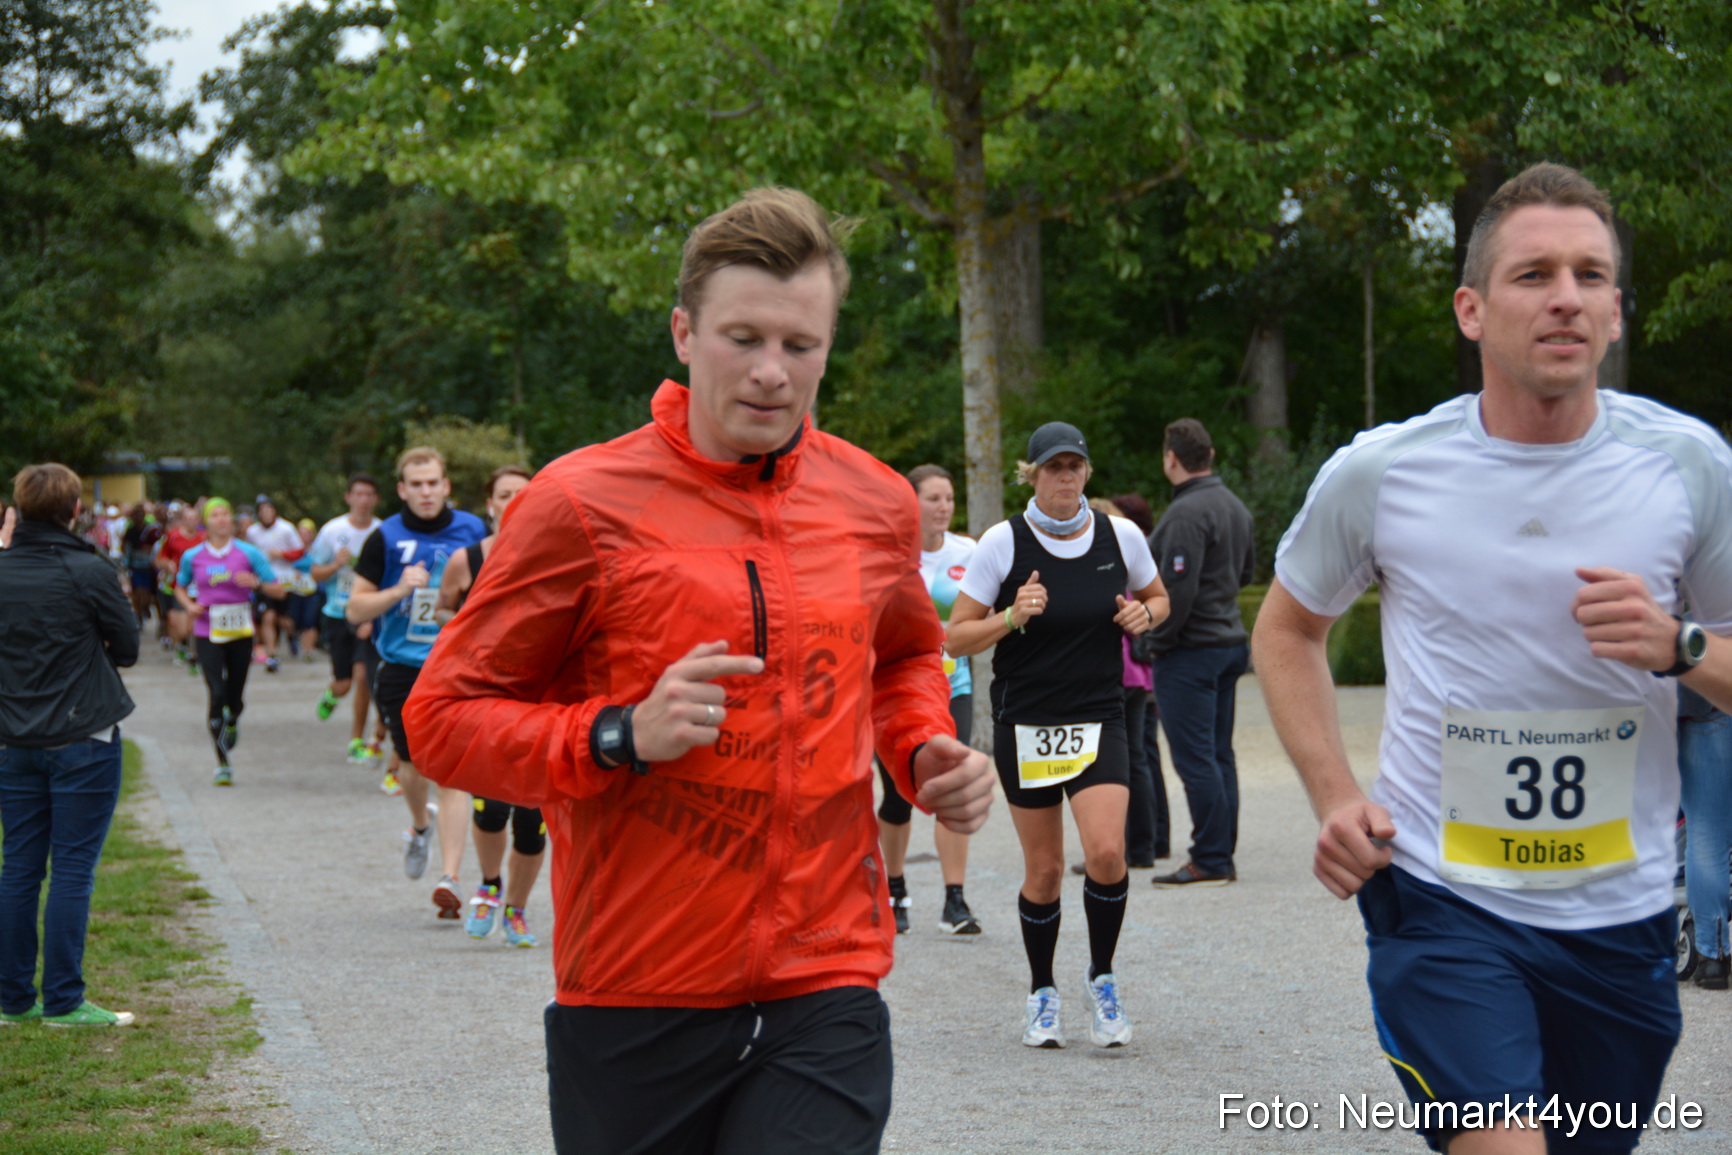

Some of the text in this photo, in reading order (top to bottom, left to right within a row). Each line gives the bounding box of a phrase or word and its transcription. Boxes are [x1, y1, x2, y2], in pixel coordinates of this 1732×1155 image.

[396, 539, 418, 564] 7
[1035, 727, 1084, 757] 325
[1447, 724, 1610, 745] PARTL Neumarkt
[1505, 755, 1586, 821] 38
[1500, 838, 1586, 864] Tobias
